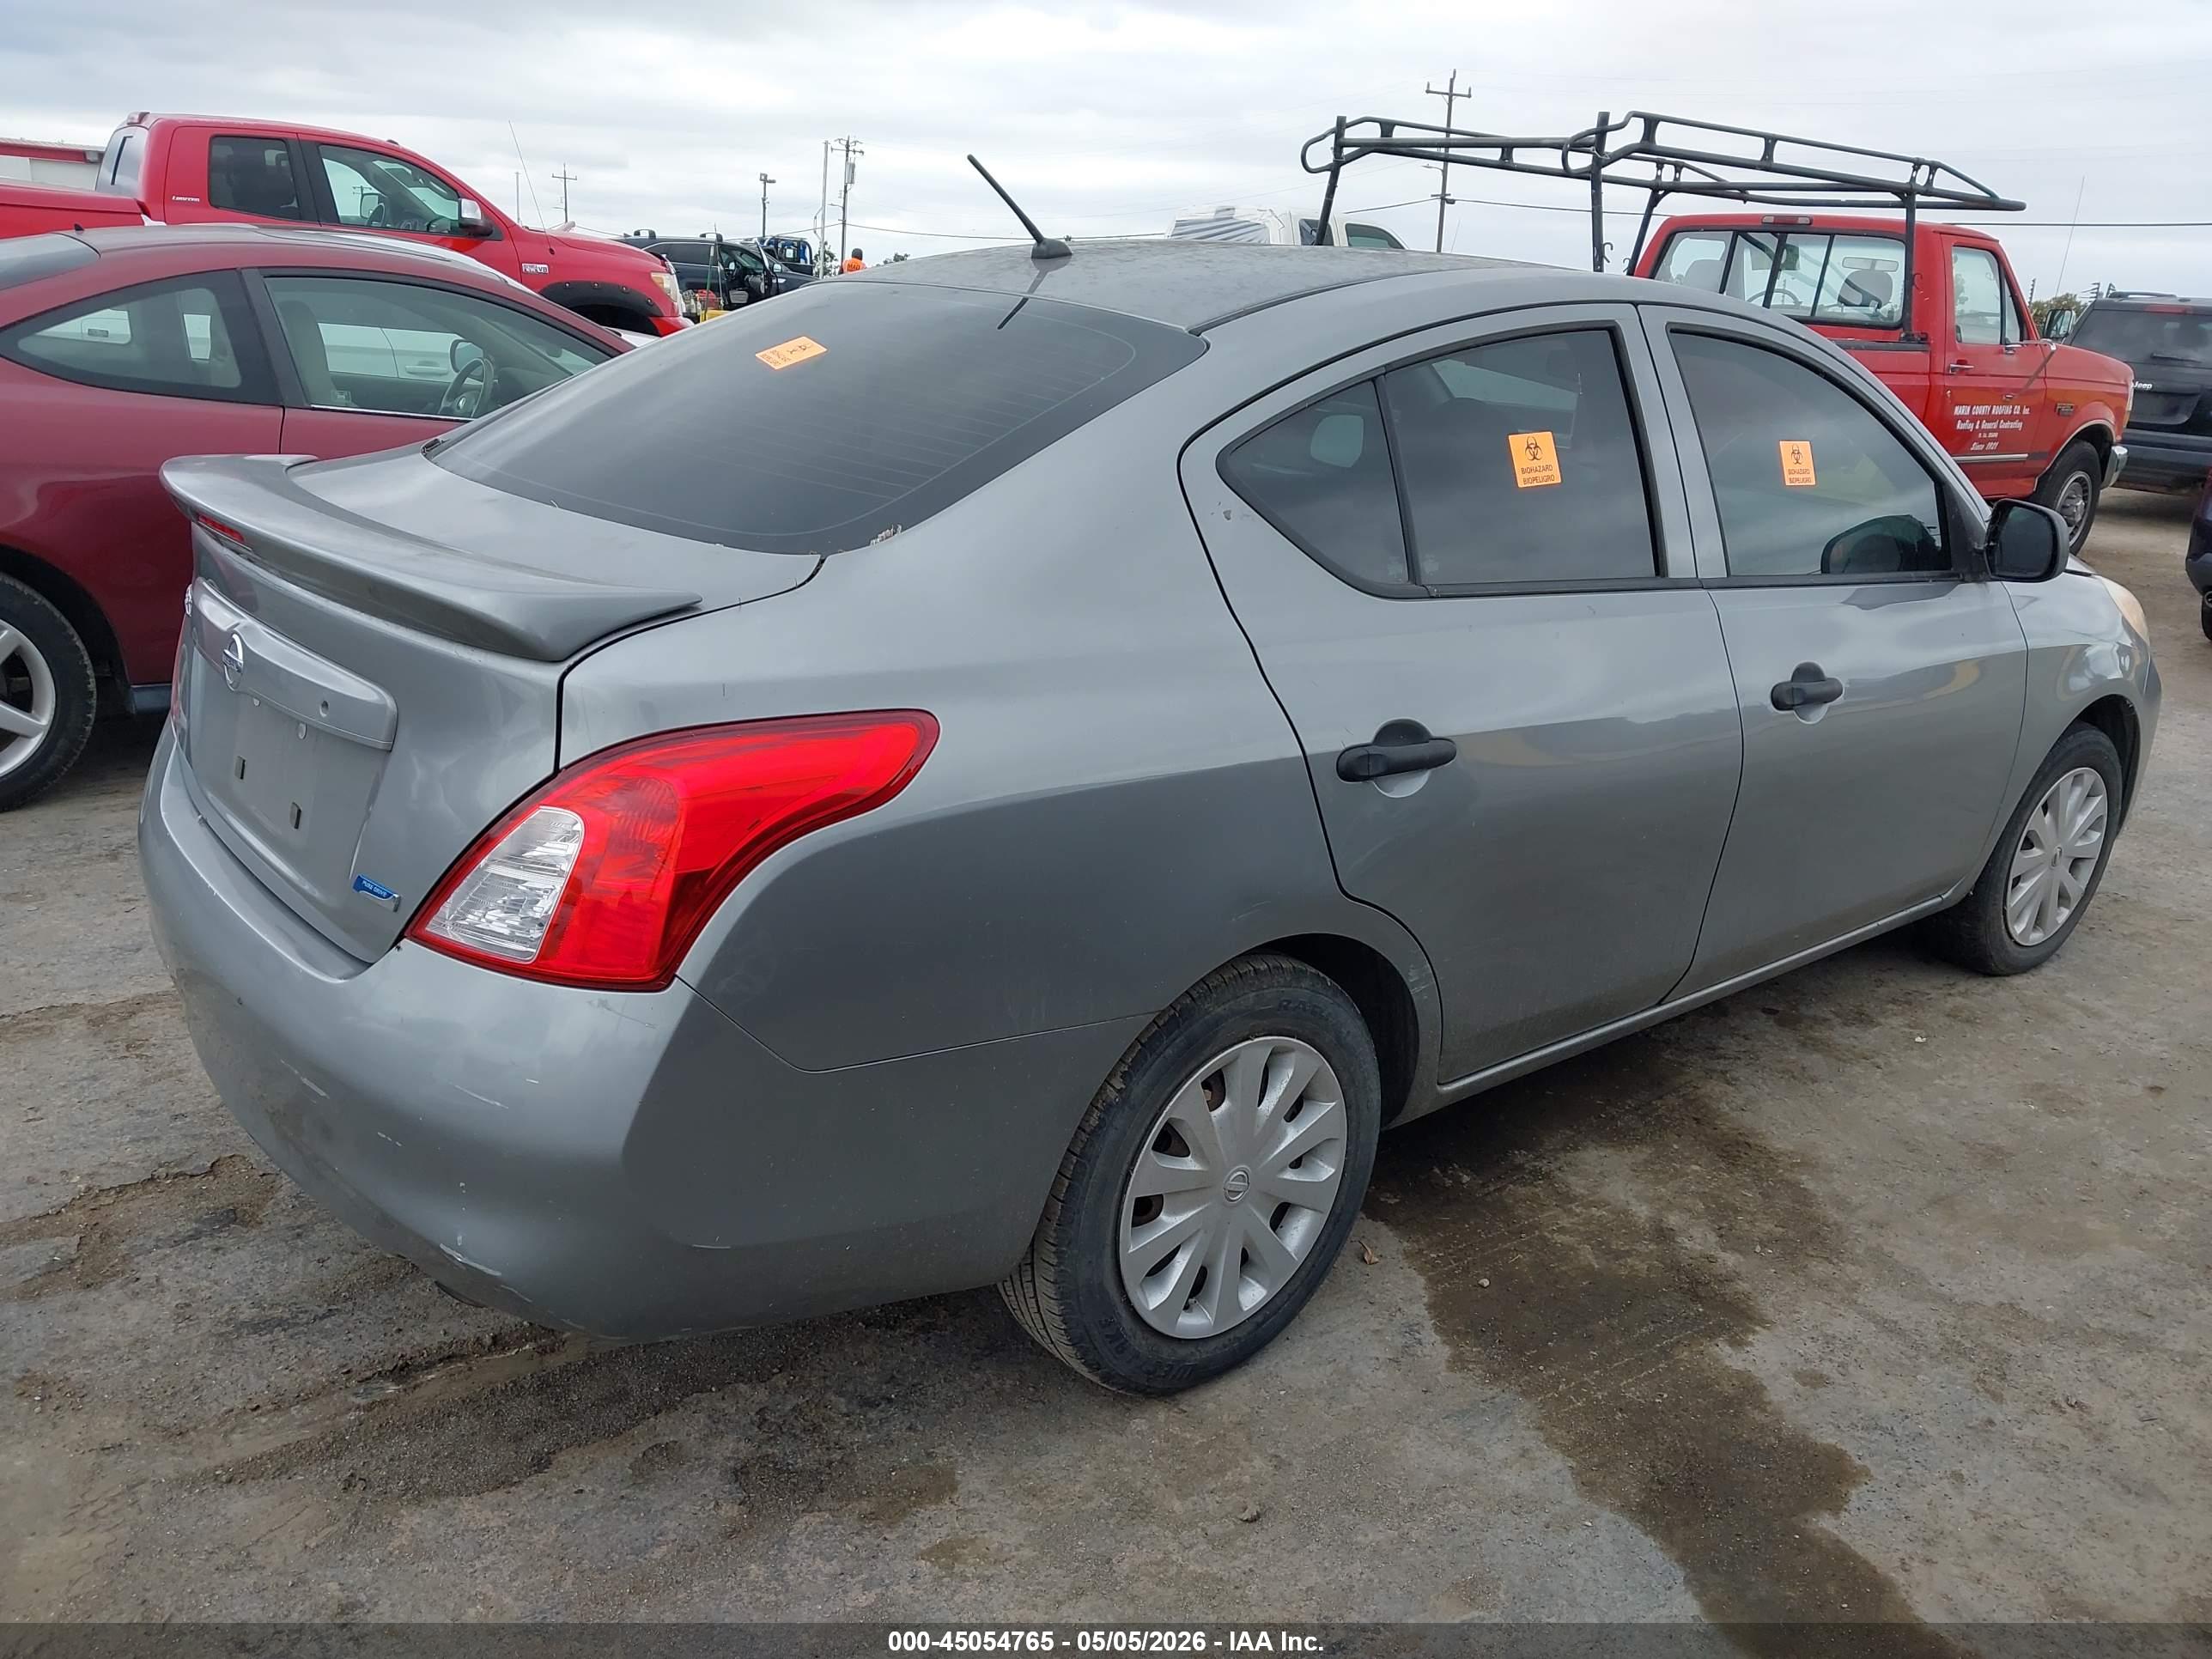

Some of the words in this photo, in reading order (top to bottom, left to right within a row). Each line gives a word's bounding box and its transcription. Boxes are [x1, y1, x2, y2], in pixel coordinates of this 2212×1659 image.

[1972, 405, 1991, 416] COUNTY
[1991, 405, 2013, 416] ROOFING
[1956, 420, 1974, 432] Roofing
[1975, 419, 1981, 429] &
[1981, 418, 1999, 429] General
[1998, 419, 2023, 431] Contracting
[1521, 465, 1553, 474] BIOHAZARD
[1523, 474, 1555, 485] BIOPELIGRO
